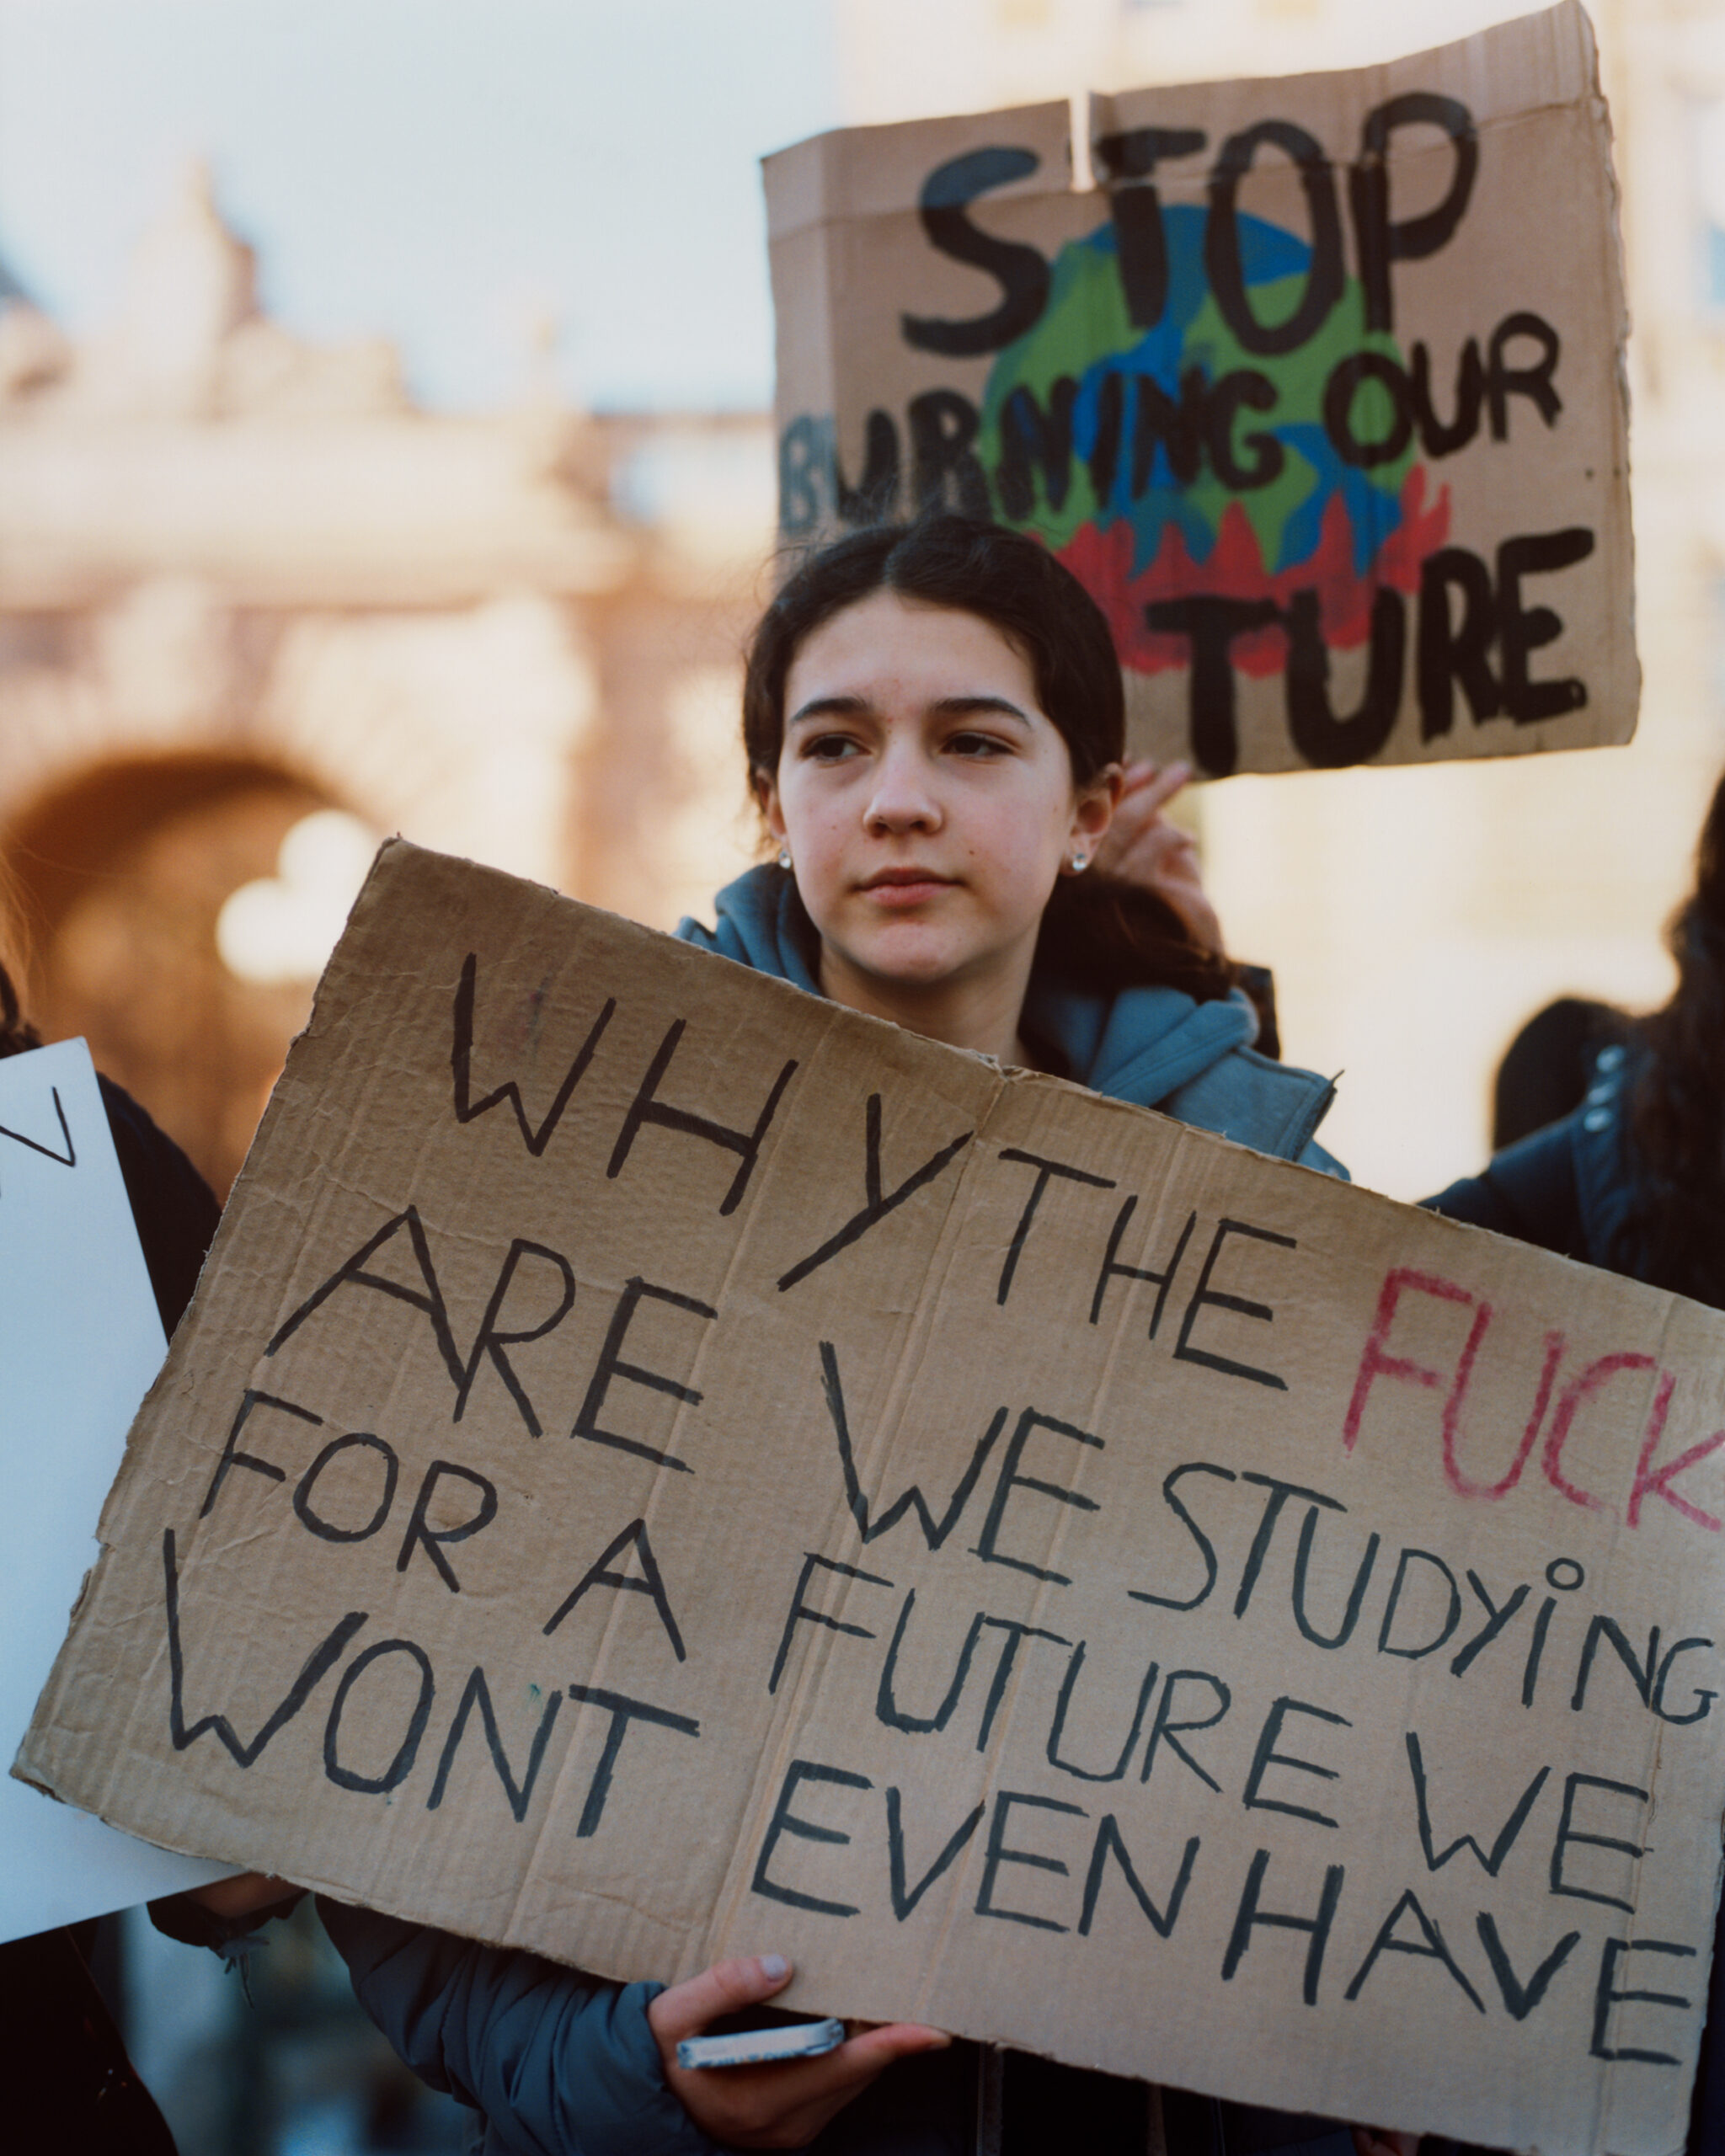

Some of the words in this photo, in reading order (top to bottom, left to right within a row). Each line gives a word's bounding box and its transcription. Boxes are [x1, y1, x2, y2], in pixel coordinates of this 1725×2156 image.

[900, 93, 1480, 357] STOP
[778, 369, 1285, 537] BURNING
[1322, 312, 1564, 468] OUR
[1144, 527, 1594, 777] TURE
[264, 1204, 718, 1475] ARE
[819, 1340, 1105, 1587] WE
[451, 952, 974, 1292] WHY
[996, 1147, 1297, 1391] THE
[1342, 1267, 1725, 1532] FUCK
[163, 1527, 701, 1838] WONT
[751, 1758, 1201, 1940] EVEN
[1221, 1848, 1698, 2067] HAVE
[199, 1388, 499, 1593] FOR
[542, 1517, 687, 1662] A
[768, 1551, 1353, 1828] FUTURE
[1407, 1732, 1655, 1914] WE
